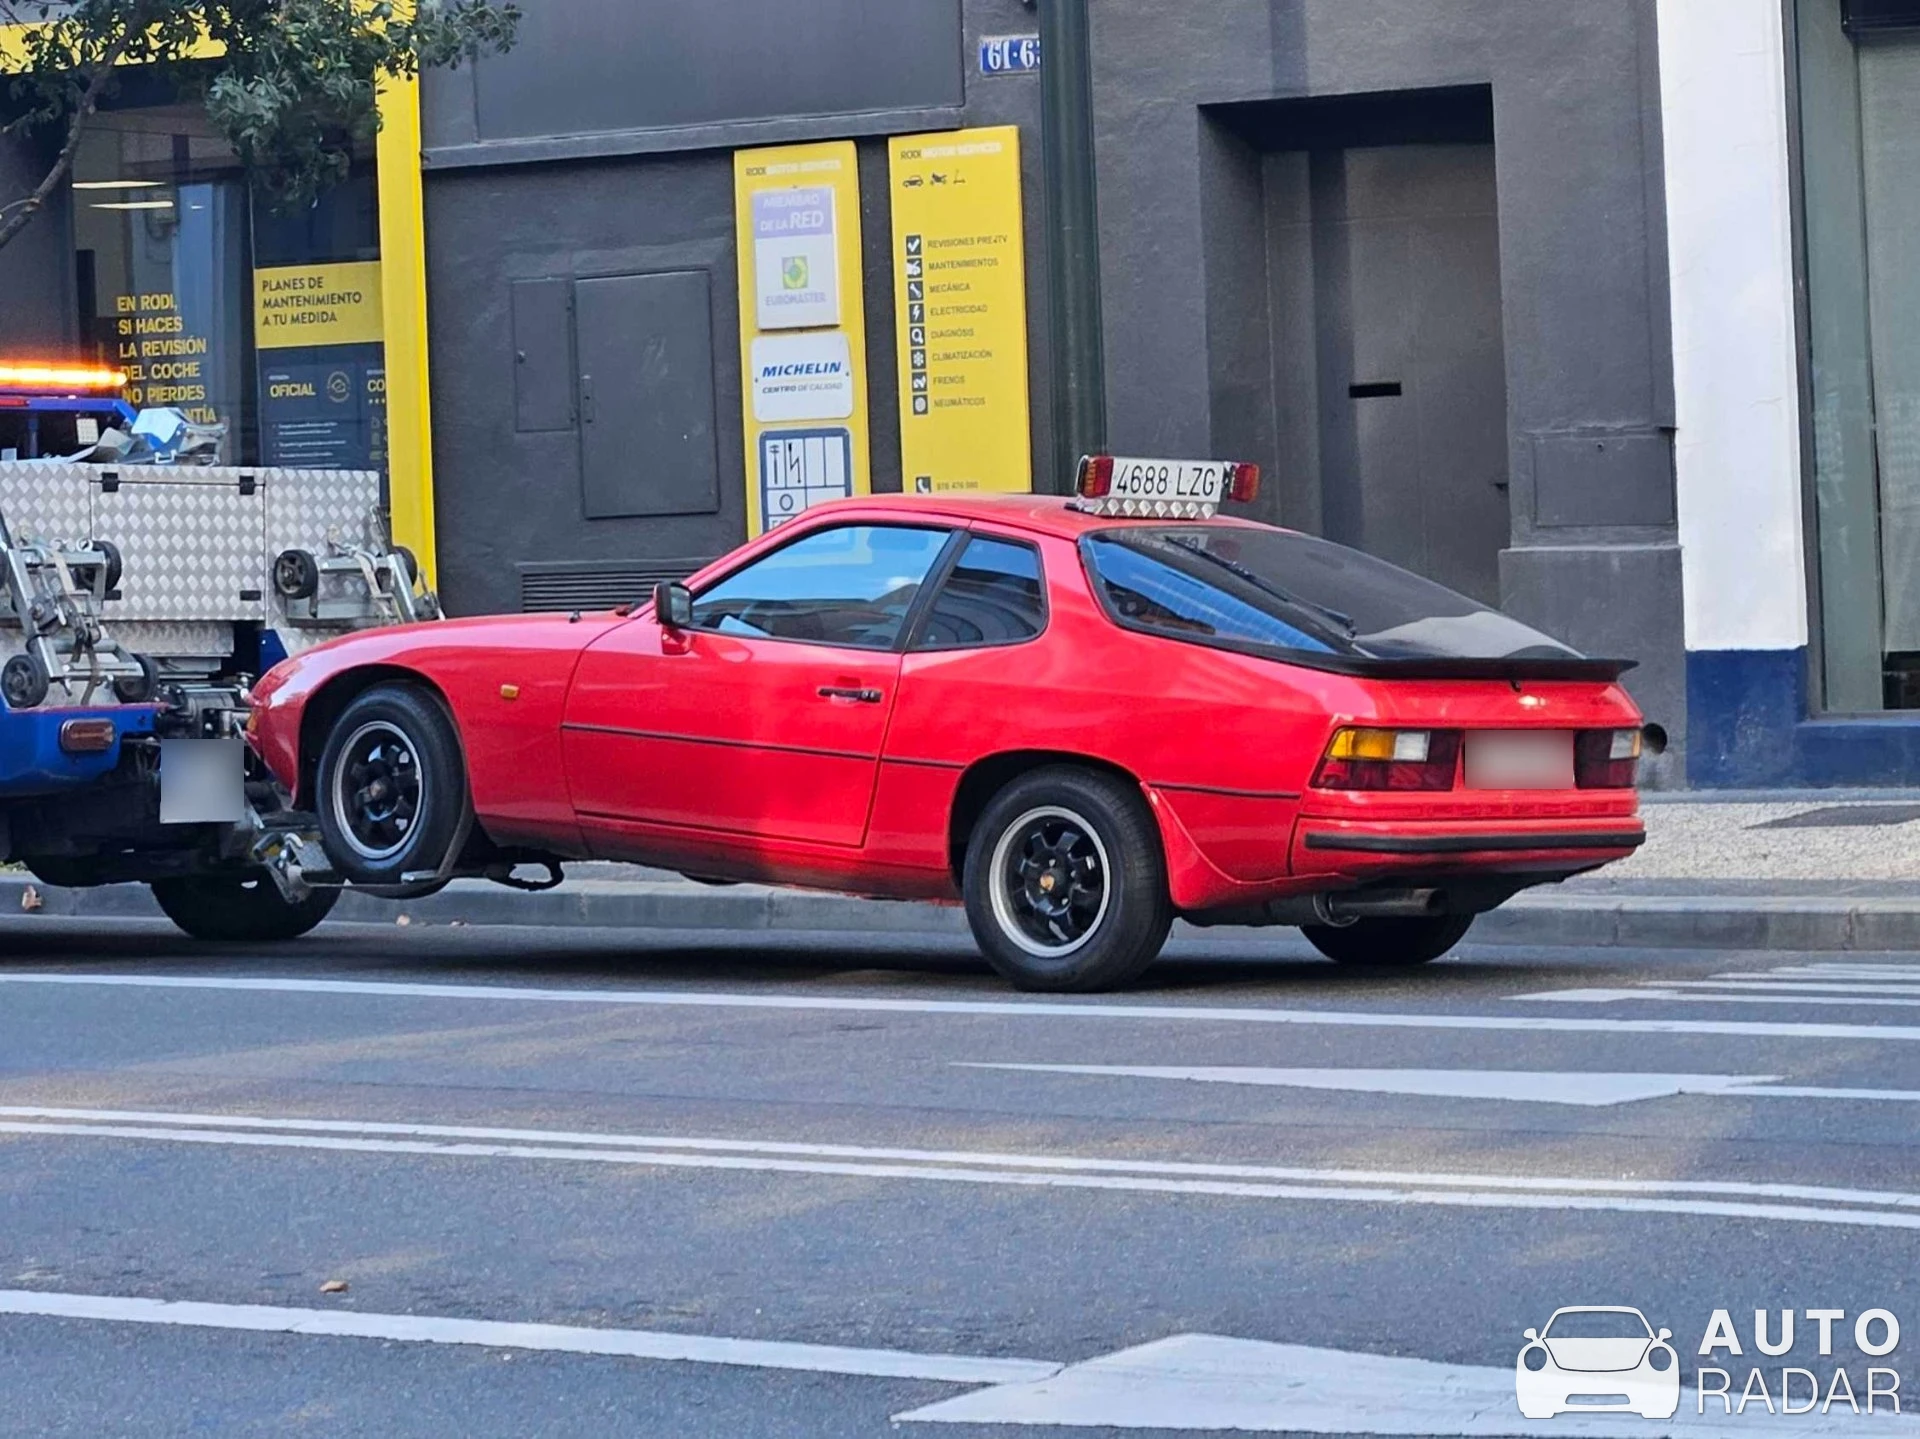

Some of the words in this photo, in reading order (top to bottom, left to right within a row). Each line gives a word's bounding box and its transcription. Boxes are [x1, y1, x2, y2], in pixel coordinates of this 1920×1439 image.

[988, 39, 1040, 70] 61·6
[760, 220, 775, 231] DE
[789, 210, 824, 229] RED
[928, 257, 999, 270] MANTENIMIENTOS
[262, 278, 305, 292] PLANES
[308, 276, 324, 289] DE
[929, 281, 971, 293] MECÁNICA
[117, 296, 136, 312] EN
[140, 294, 178, 312] RODI,
[262, 291, 362, 309] MANTENIMIENTO
[765, 291, 827, 306] EUROMASTER
[930, 304, 988, 316] ELECTRICIDAD
[118, 319, 132, 335] SI
[136, 316, 183, 334] HACES
[262, 315, 271, 326] A
[273, 313, 287, 325] TU
[290, 311, 337, 325] MEDIDA
[119, 342, 137, 358] LA
[142, 335, 206, 357] REVISIÓN
[932, 349, 992, 361] CLIMATIZACIÓN
[120, 365, 147, 381] DEL
[151, 361, 201, 379] COCHE
[762, 361, 841, 378] MICHELIN
[367, 379, 385, 392] CO
[933, 375, 965, 385] FRENOS
[122, 387, 143, 404] NO
[147, 384, 206, 403] PIERDES
[270, 383, 316, 398] OFICIAL
[762, 385, 797, 394] CENTRO
[810, 382, 843, 391] CALIDAD
[934, 397, 986, 408] NEUMÁTICOS
[1116, 464, 1169, 495] 4688
[1176, 467, 1216, 497] LZG
